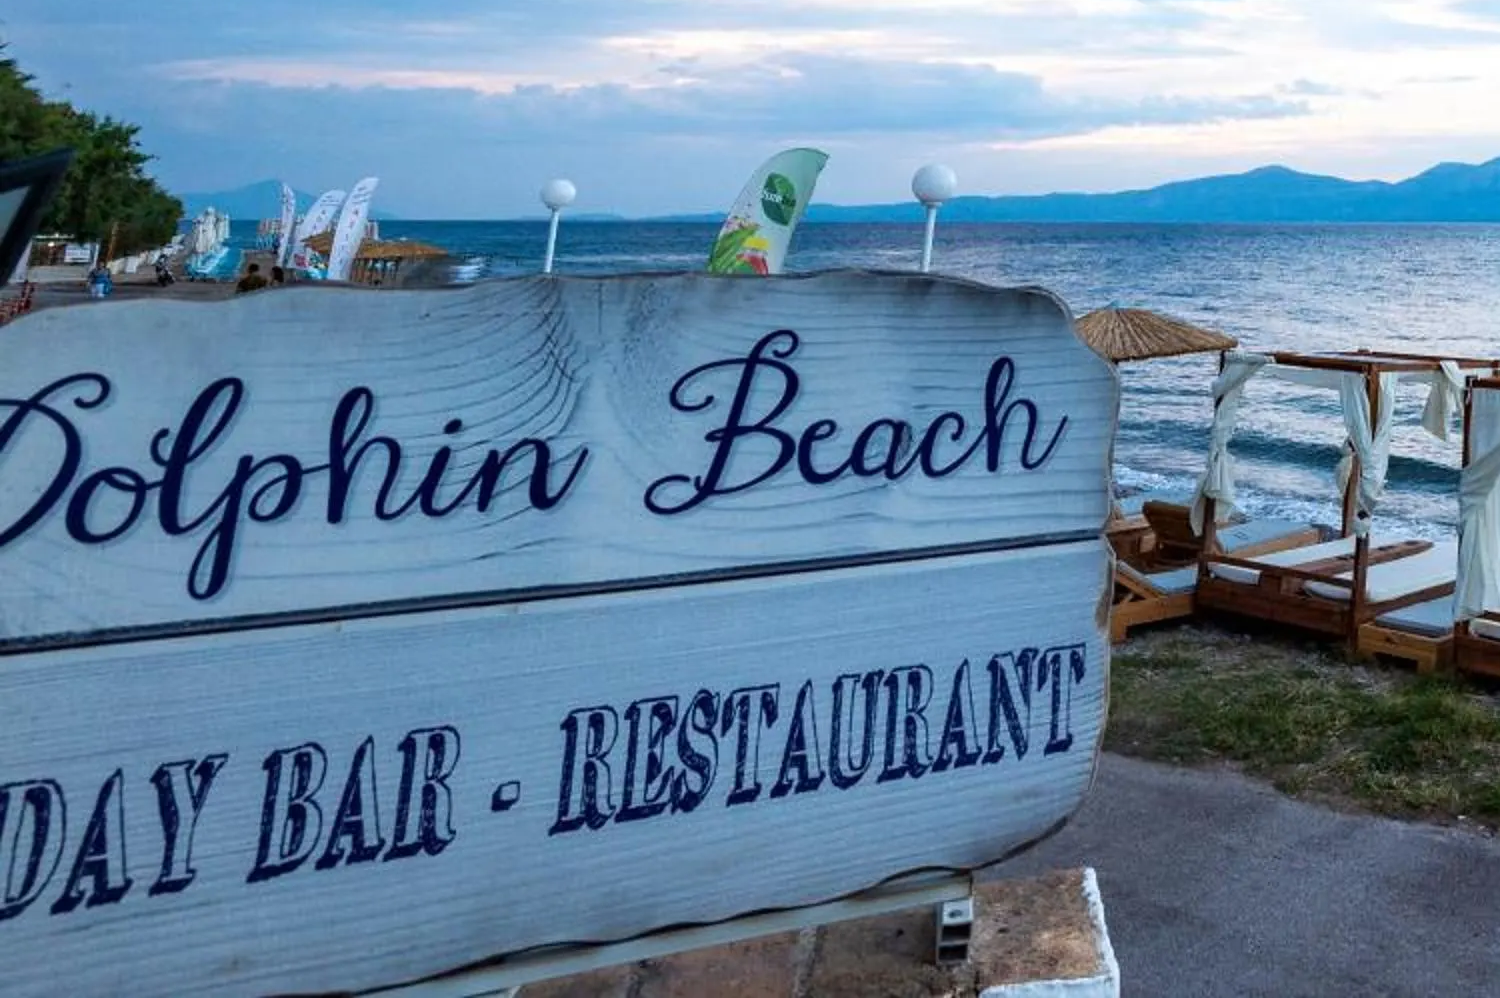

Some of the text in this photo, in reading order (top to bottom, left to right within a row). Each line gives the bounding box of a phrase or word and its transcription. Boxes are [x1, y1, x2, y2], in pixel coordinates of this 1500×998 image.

[0, 329, 1068, 600] Dolphin Beach
[0, 753, 229, 921] DAY
[246, 726, 463, 885] BAR
[548, 642, 1087, 834] RESTAURANT
